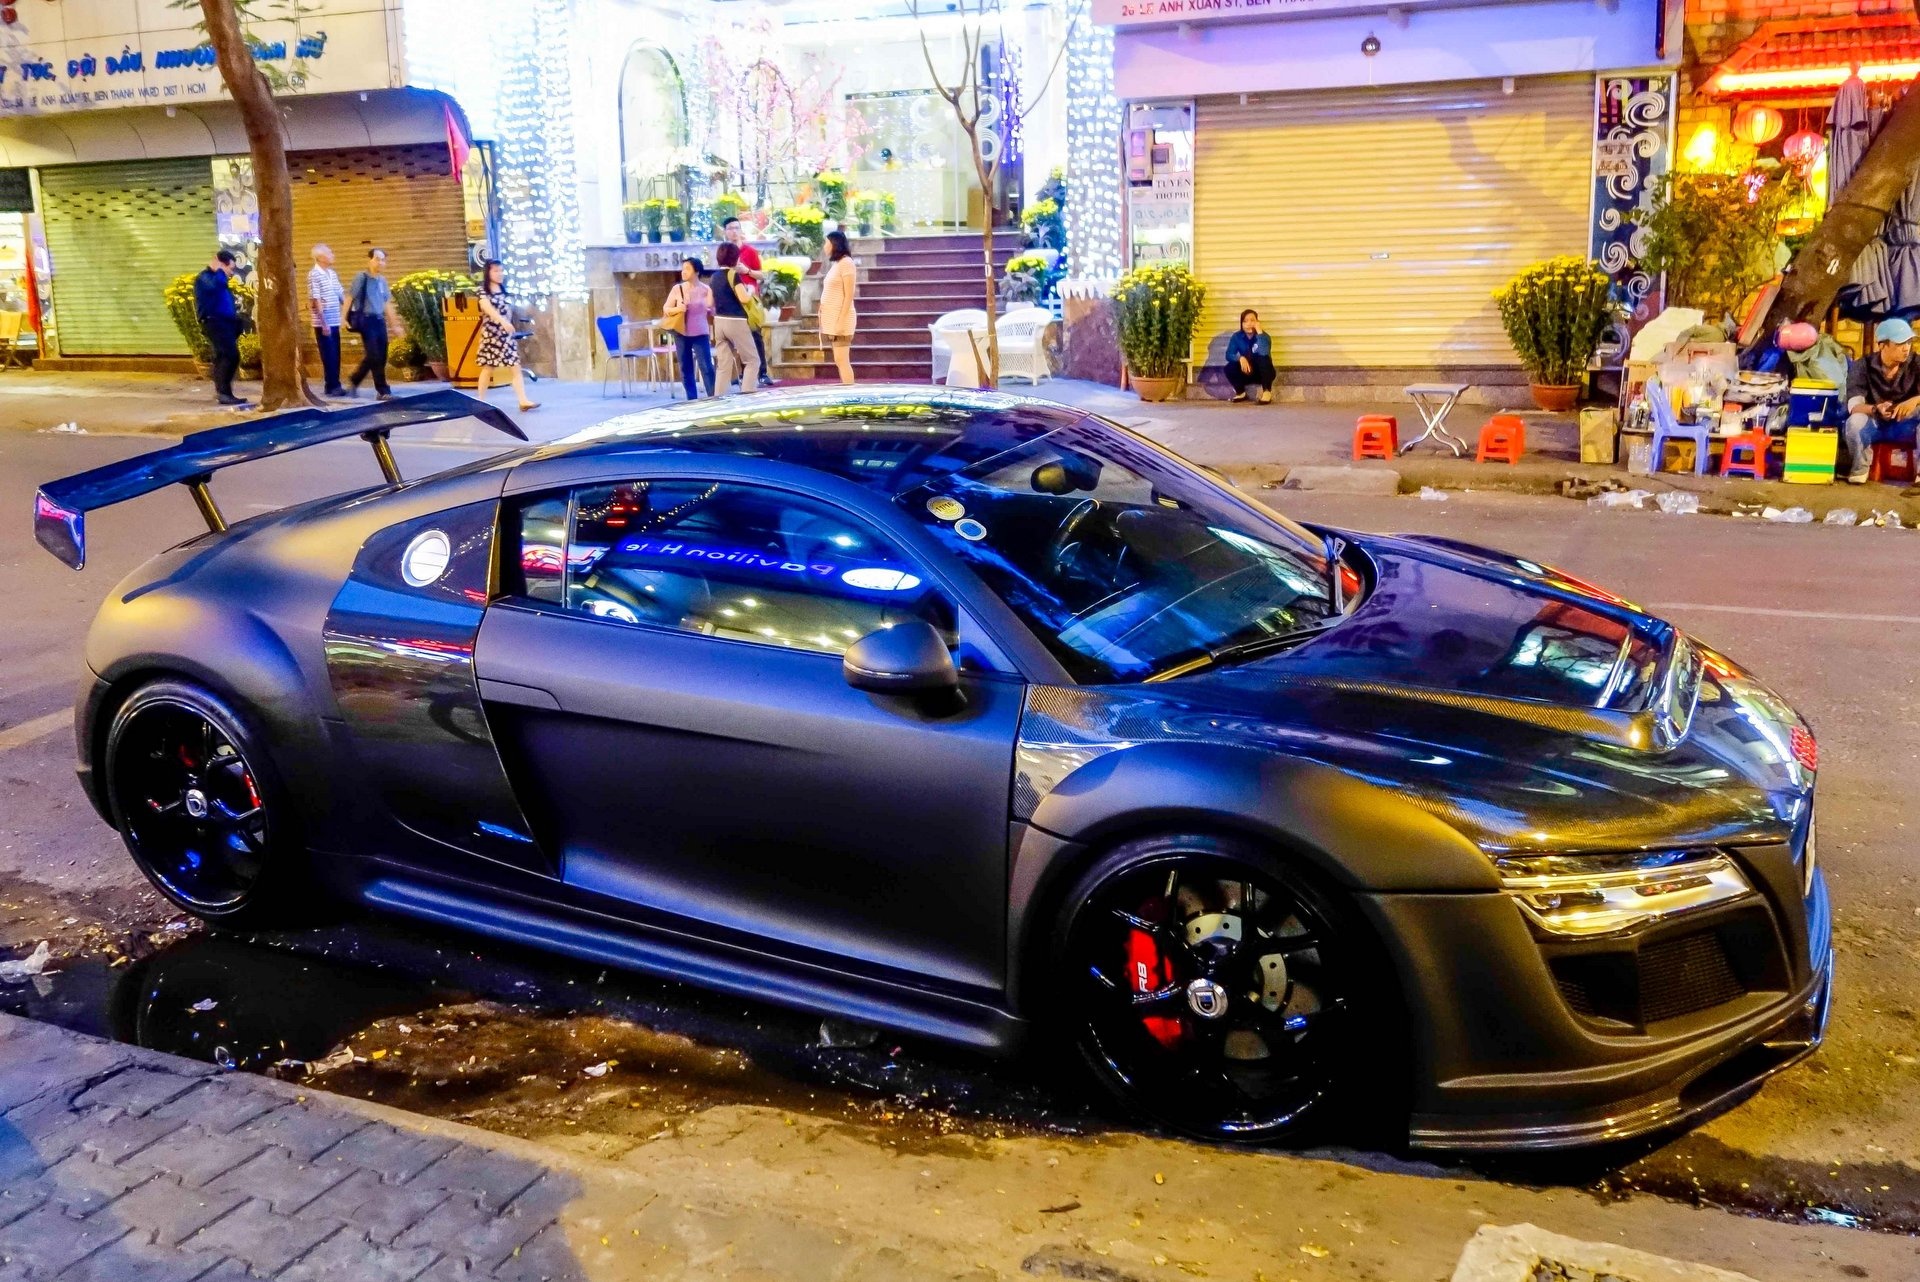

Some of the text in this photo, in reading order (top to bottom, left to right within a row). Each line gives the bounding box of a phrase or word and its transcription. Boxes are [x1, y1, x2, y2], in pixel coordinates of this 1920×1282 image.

[1159, 2, 1184, 12] ANH
[1188, 0, 1221, 11] XUAN
[110, 88, 135, 99] THANH
[138, 86, 160, 98] WARD
[187, 83, 206, 94] HCM
[1137, 961, 1149, 992] R8
